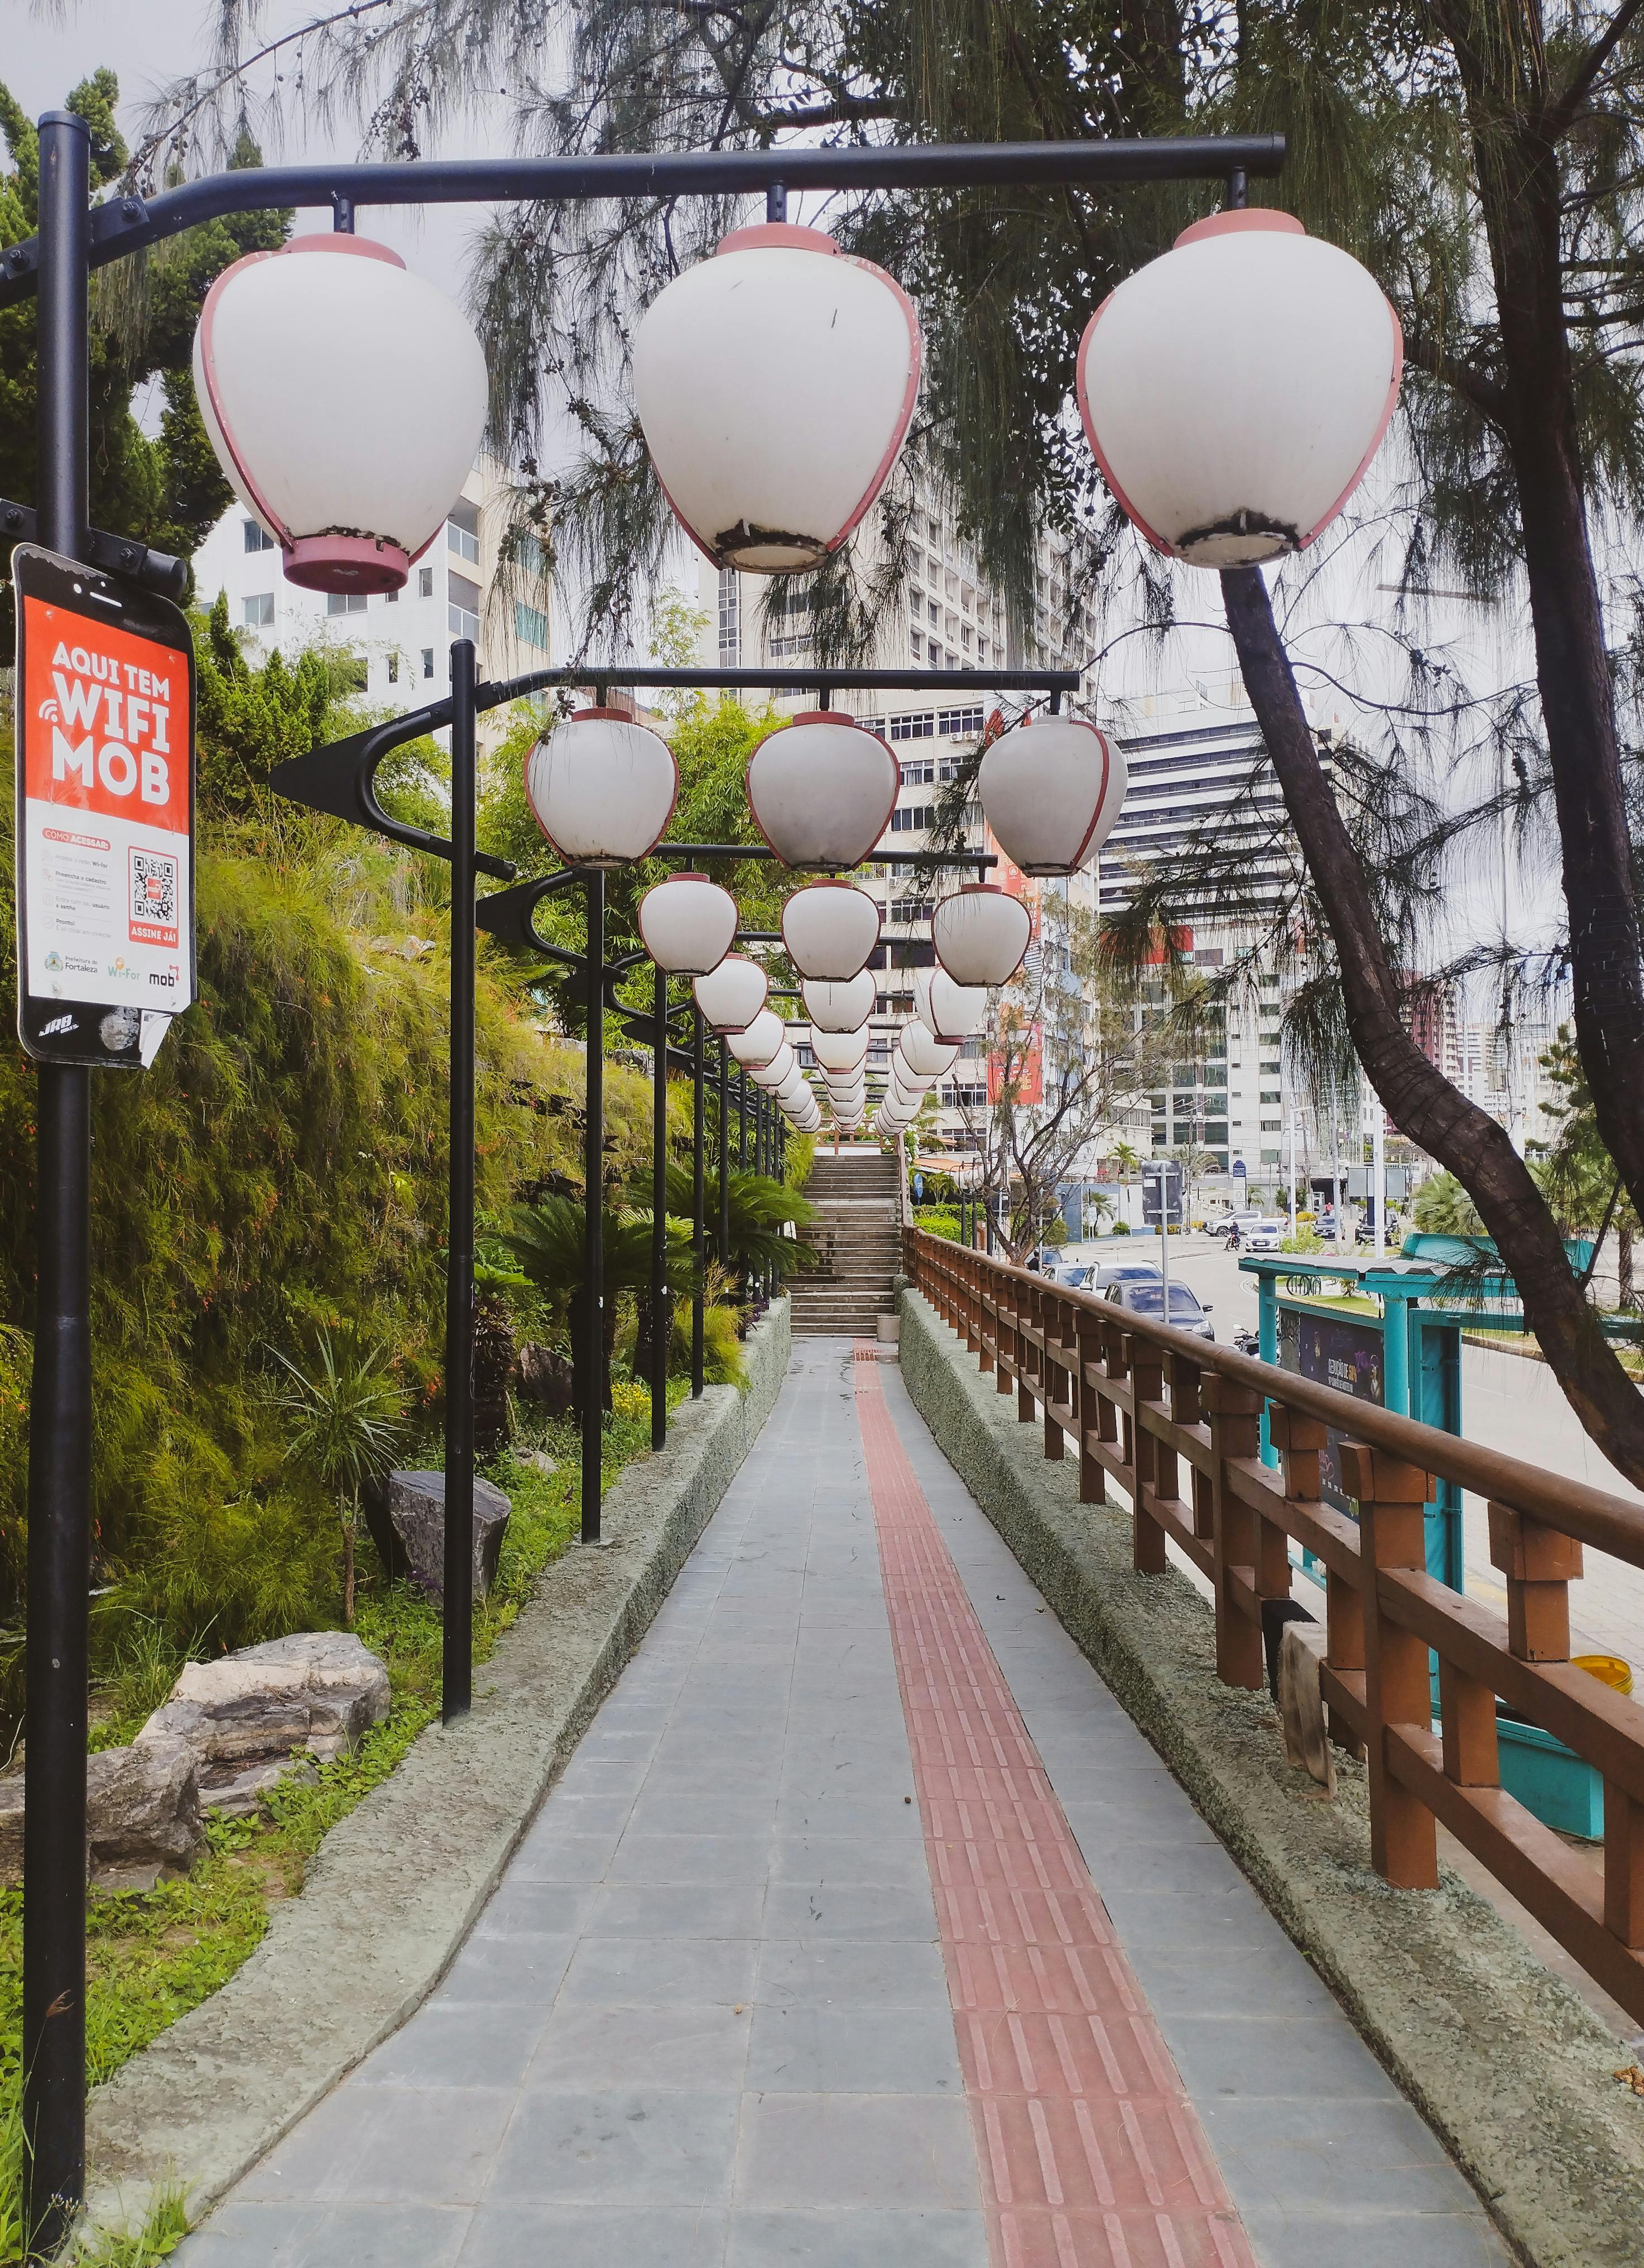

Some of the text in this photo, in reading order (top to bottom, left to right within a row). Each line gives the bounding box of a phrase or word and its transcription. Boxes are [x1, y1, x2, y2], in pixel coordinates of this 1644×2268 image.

[52, 641, 170, 701] AQUI TEM
[52, 671, 170, 753] WIFI
[52, 725, 170, 805] MOB
[45, 830, 108, 849] COMO ACESSAR:
[131, 926, 161, 940] ASSINE
[65, 963, 98, 973] Fortaleza
[108, 966, 141, 981] Wi-For
[149, 973, 174, 987] mob
